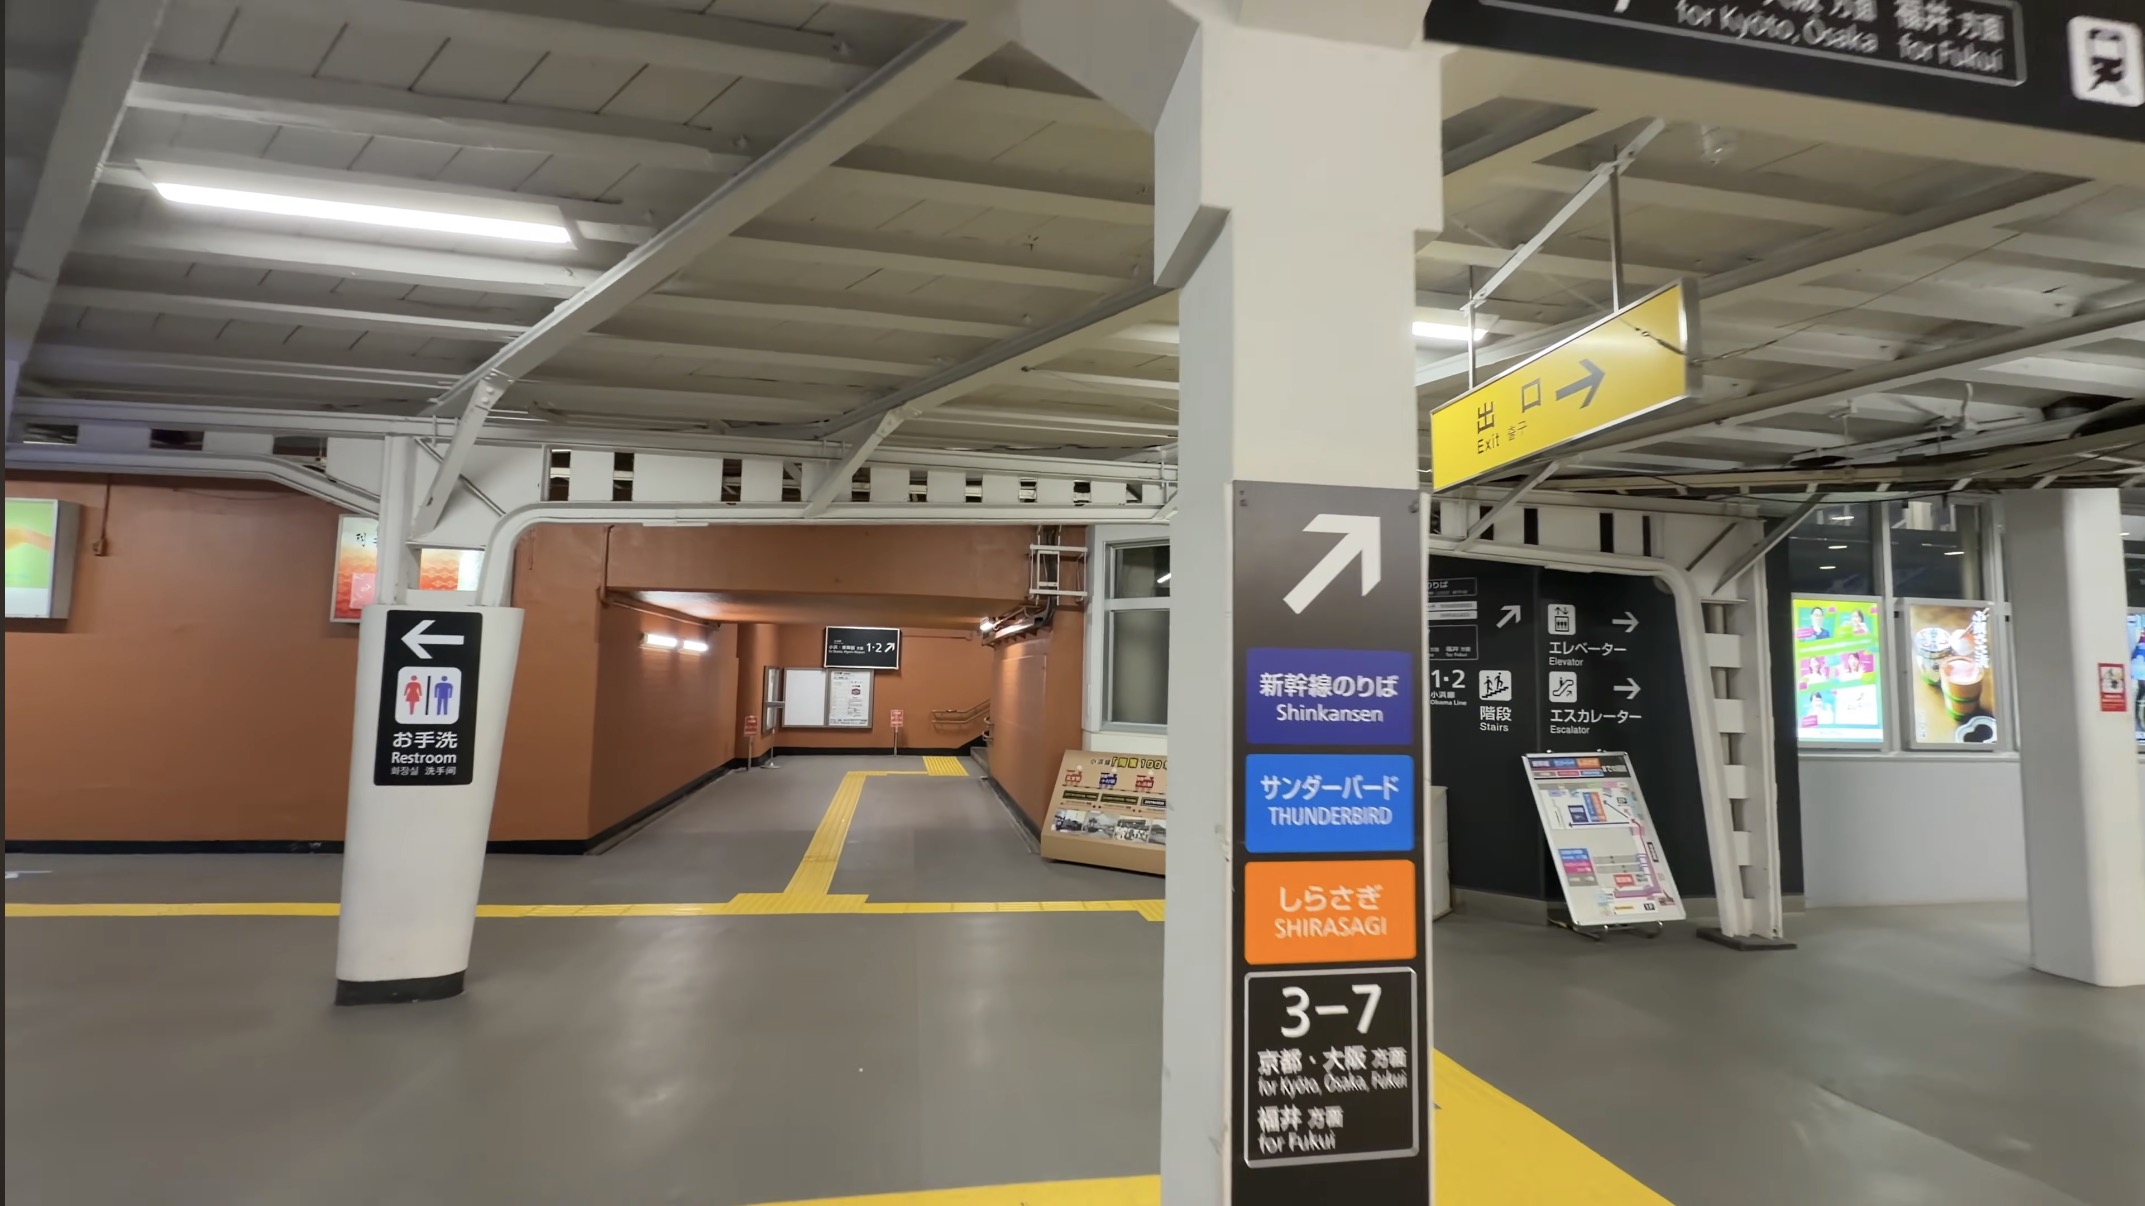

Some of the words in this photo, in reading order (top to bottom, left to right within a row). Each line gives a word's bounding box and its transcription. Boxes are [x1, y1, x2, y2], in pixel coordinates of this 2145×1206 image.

[1899, 31, 1937, 62] for
[1938, 40, 2004, 73] Fukui
[1477, 433, 1500, 454] Exit
[1549, 641, 1627, 656] エレベーター
[1549, 657, 1584, 667] Elevator
[1259, 672, 1399, 699] 新幹線のりば
[1275, 704, 1384, 723] Shinkansen
[1480, 705, 1512, 722] 階段
[1550, 709, 1642, 724] エスカレーター
[1479, 722, 1509, 732] Stairs
[1550, 725, 1591, 735] Escalator
[392, 731, 458, 749] お手洗
[391, 751, 457, 764] Restroom
[1260, 775, 1399, 800] サンダーバード
[1268, 806, 1393, 826] THUNDERBIRD
[1279, 884, 1383, 913] しらさぎ
[1274, 914, 1387, 938] SHIRASAGI
[1257, 1075, 1279, 1097] for
[1257, 1132, 1286, 1154] for
[1288, 1130, 1336, 1152] Fukui
